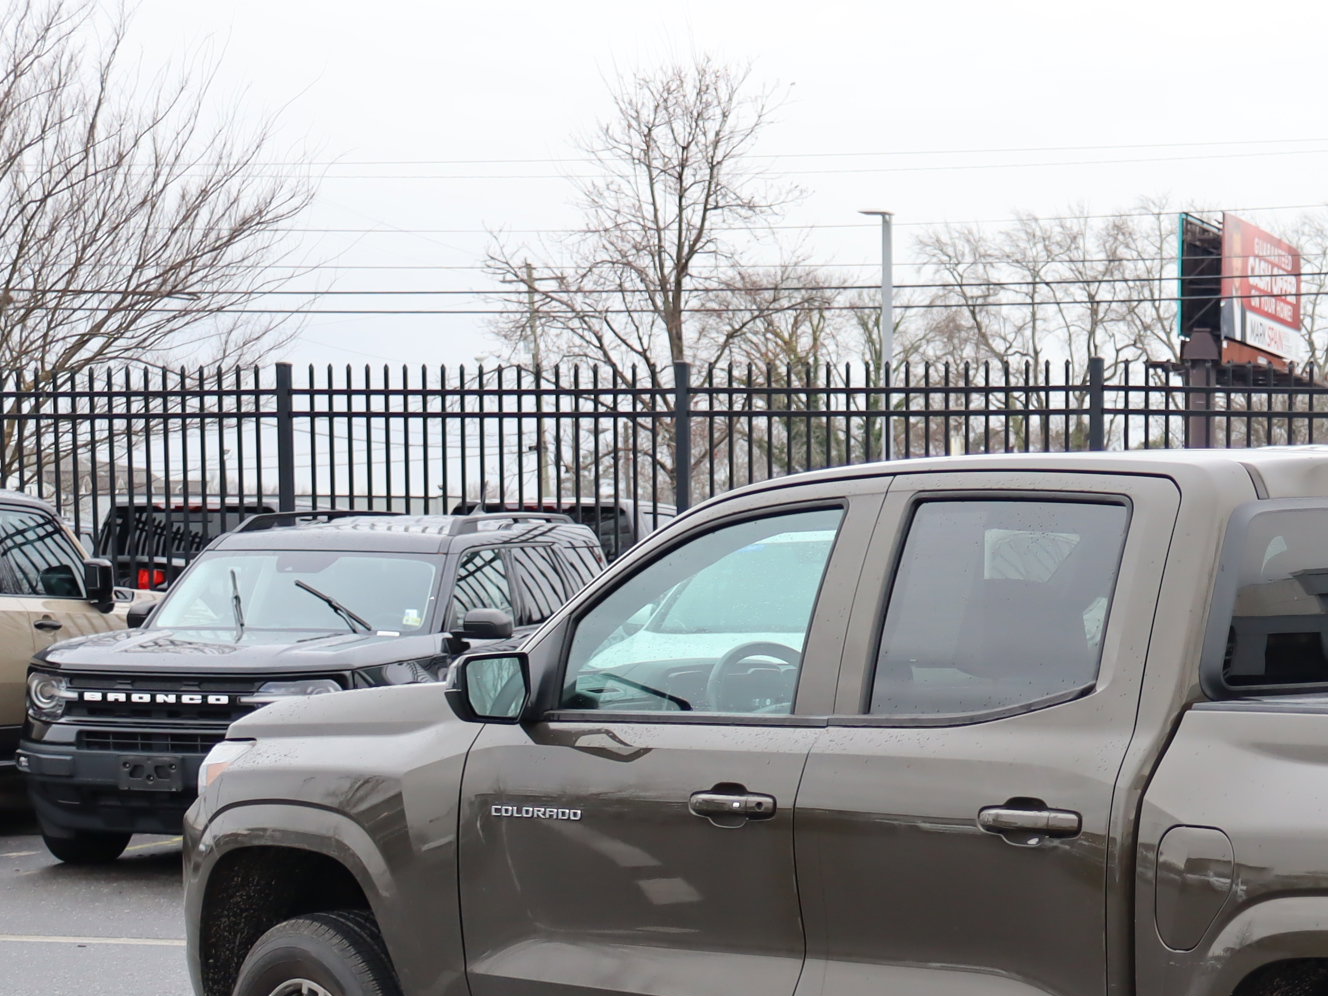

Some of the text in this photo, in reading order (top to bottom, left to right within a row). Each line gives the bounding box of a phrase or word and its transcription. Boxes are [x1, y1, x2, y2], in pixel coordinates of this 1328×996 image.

[1248, 256, 1271, 292] CASH
[83, 691, 229, 705] BRONCO
[491, 804, 582, 821] COLORADO
